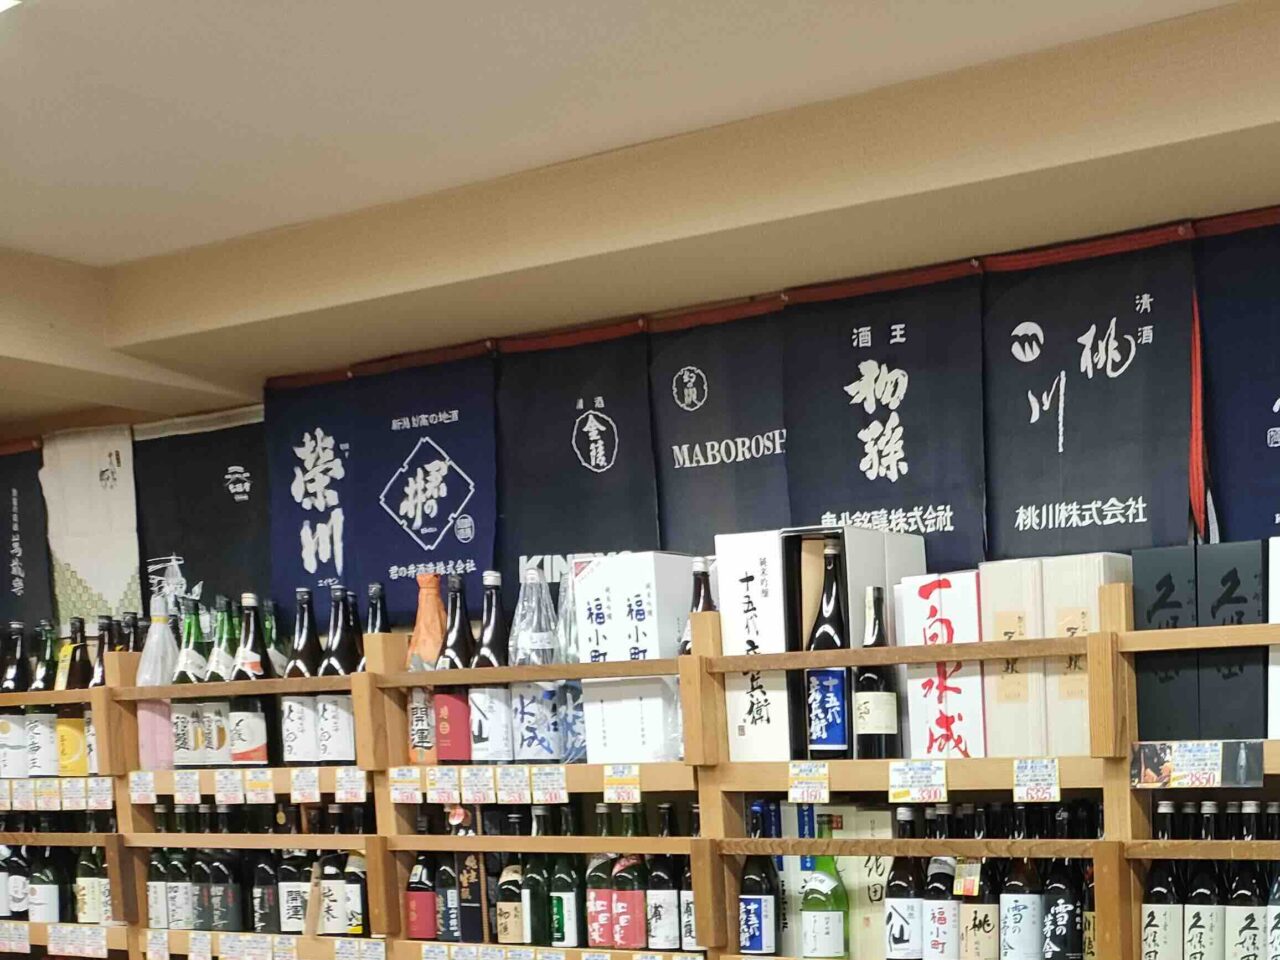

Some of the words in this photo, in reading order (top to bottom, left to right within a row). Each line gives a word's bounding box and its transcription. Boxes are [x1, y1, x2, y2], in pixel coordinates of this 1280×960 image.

[1134, 292, 1155, 345] 清酒
[1026, 316, 1138, 453] 桃川
[1014, 495, 1147, 532] 桃川株式会社
[917, 787, 942, 802] 3300
[1025, 787, 1052, 802] 6325
[1186, 772, 1216, 787] 3850
[930, 907, 948, 955] 福小町
[1050, 898, 1075, 936] 雪の
